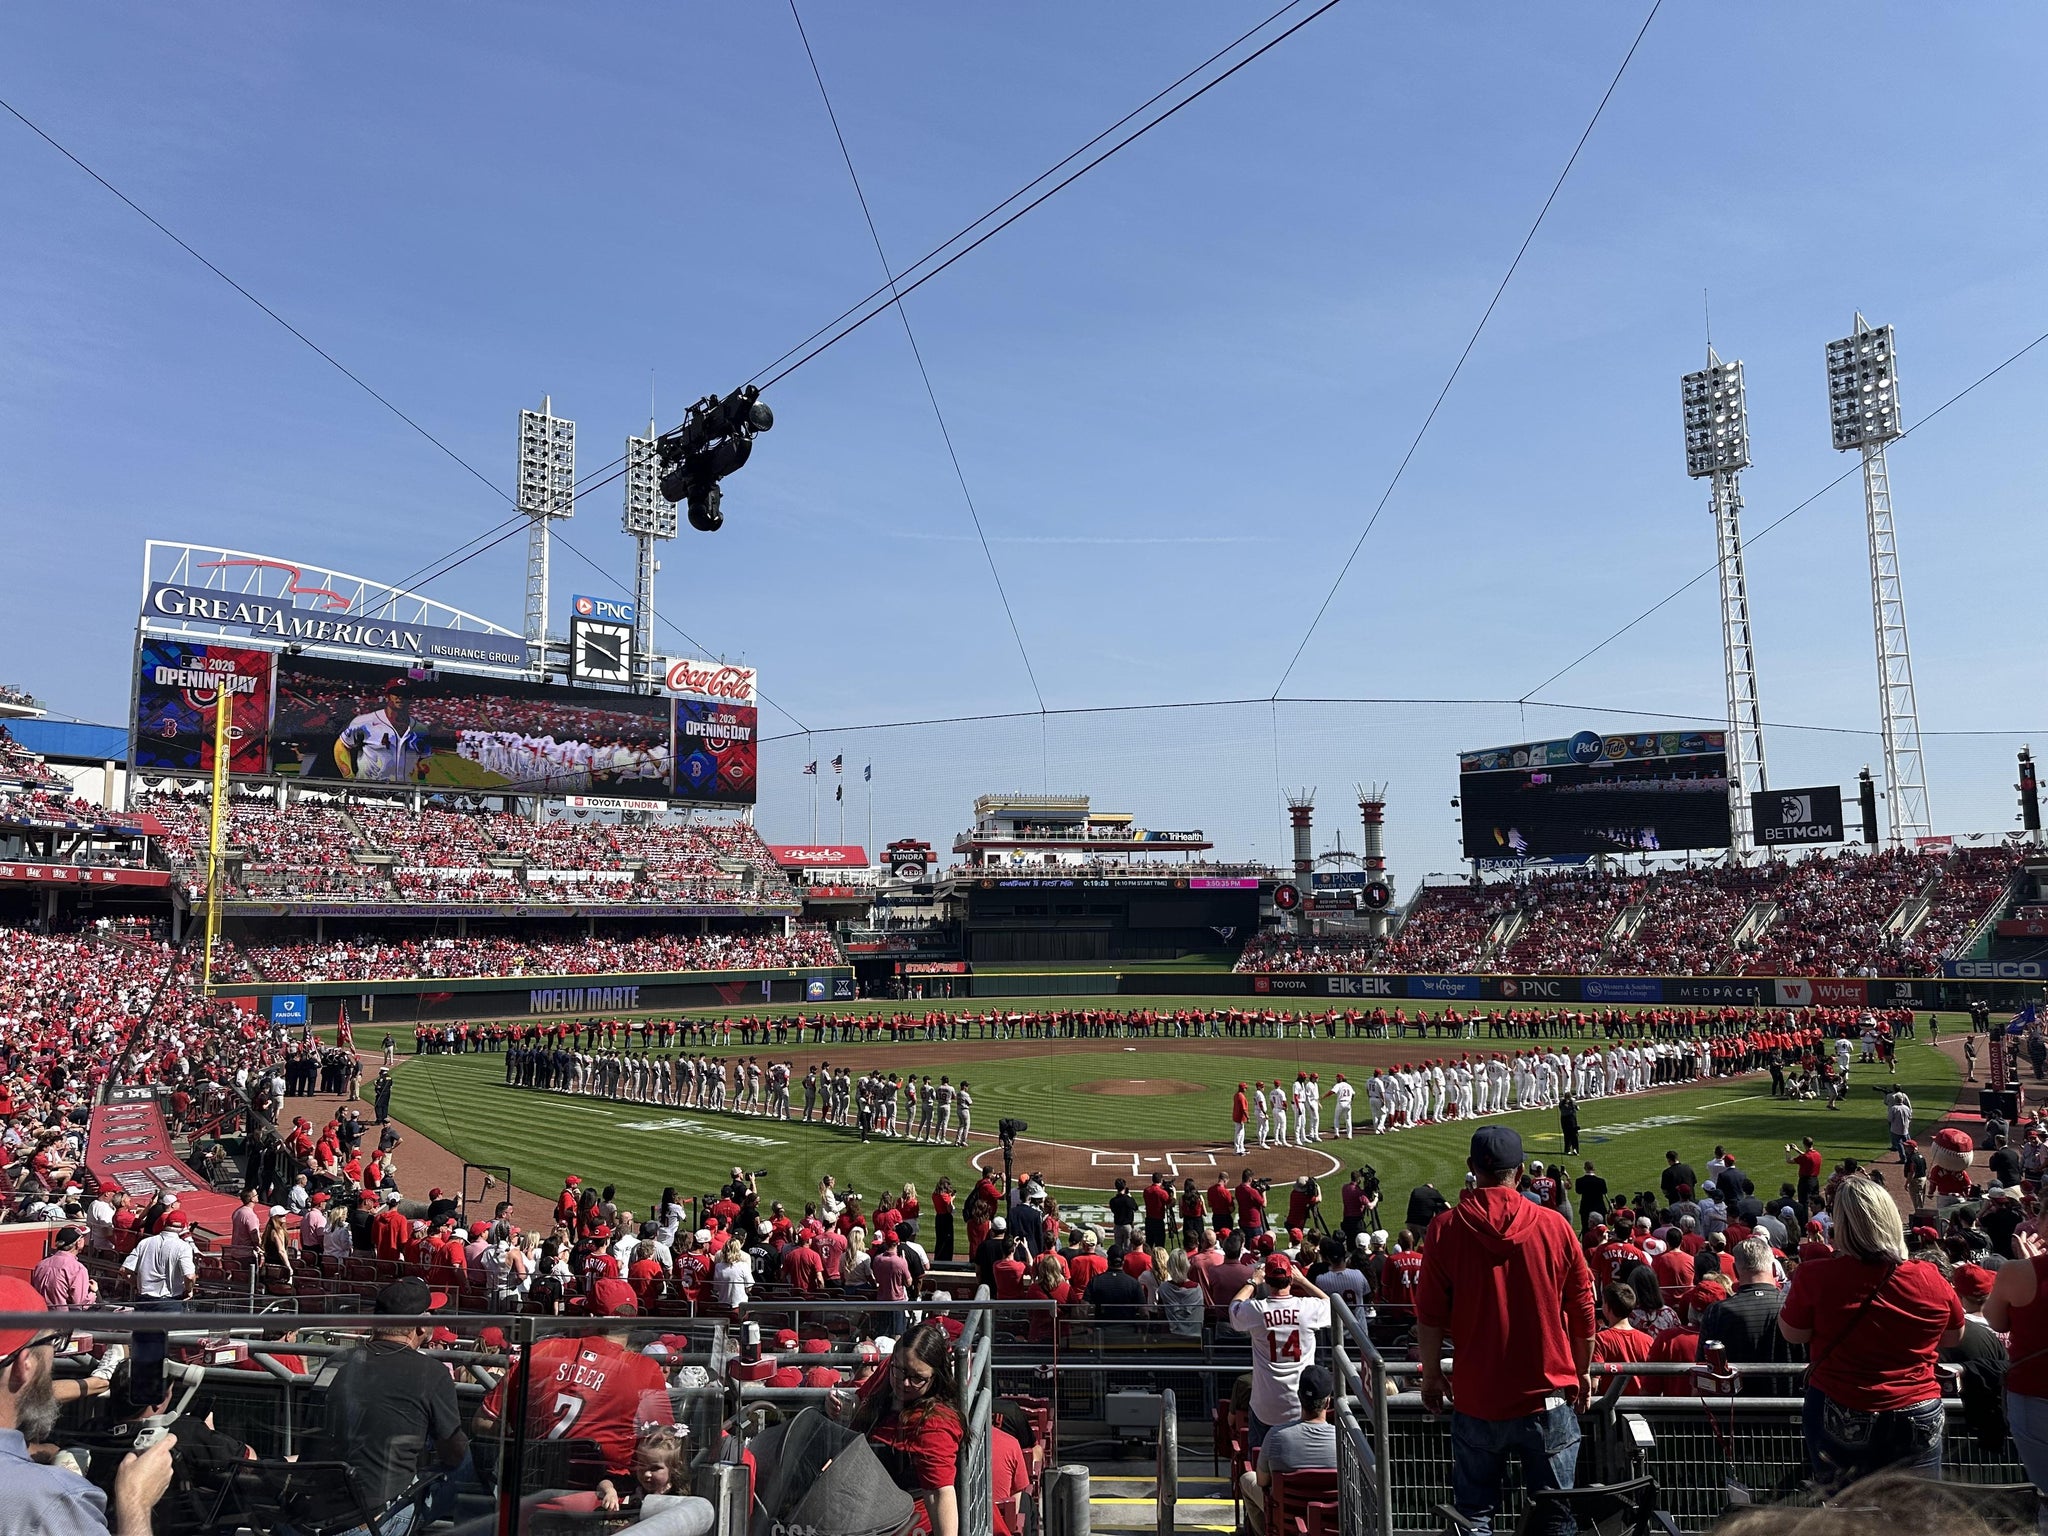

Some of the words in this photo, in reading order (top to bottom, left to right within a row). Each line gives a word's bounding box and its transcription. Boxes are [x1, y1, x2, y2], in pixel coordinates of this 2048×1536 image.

[595, 601, 633, 620] PNC
[154, 587, 272, 625] GREAT
[430, 645, 485, 660] INSURANCE
[488, 652, 520, 664] GROUP
[209, 658, 236, 672] 2026
[155, 666, 225, 689] OPENING
[226, 673, 258, 693] DAY
[667, 661, 756, 700] Coca-Cola
[719, 714, 737, 724] 2026
[686, 720, 730, 739] OPENING
[731, 725, 751, 740] DAY
[1575, 741, 1599, 754] P&G
[1605, 742, 1625, 754] Tide
[587, 798, 621, 807] TOYOTA
[623, 800, 659, 809] TUNDRA
[1168, 832, 1203, 841] TriHealth
[1765, 824, 1832, 840] BETMGM
[784, 849, 846, 860] Reds
[892, 853, 924, 861] TUNDRA
[1479, 859, 1522, 869] BEACON
[1332, 873, 1357, 883] PNC
[905, 963, 930, 973] STAR
[1955, 962, 2041, 977] GEICO
[761, 980, 771, 1002] 4
[1272, 981, 1307, 989] TOYOTA
[1435, 978, 1466, 996] Kroger
[1520, 981, 1561, 997] PNC
[1681, 985, 1753, 997] MEDPACE
[1818, 985, 1861, 999] Wyler
[361, 994, 374, 1021] 4
[530, 988, 584, 1014] NOELVI
[587, 986, 640, 1011] MARTE
[1540, 1187, 1550, 1201] 5
[584, 1257, 607, 1273] ARKIN
[678, 1257, 704, 1272] BENCH
[1264, 1309, 1300, 1328] ROSE
[1267, 1330, 1302, 1363] 14
[556, 1363, 606, 1392] STEER
[553, 1393, 586, 1440] 7
